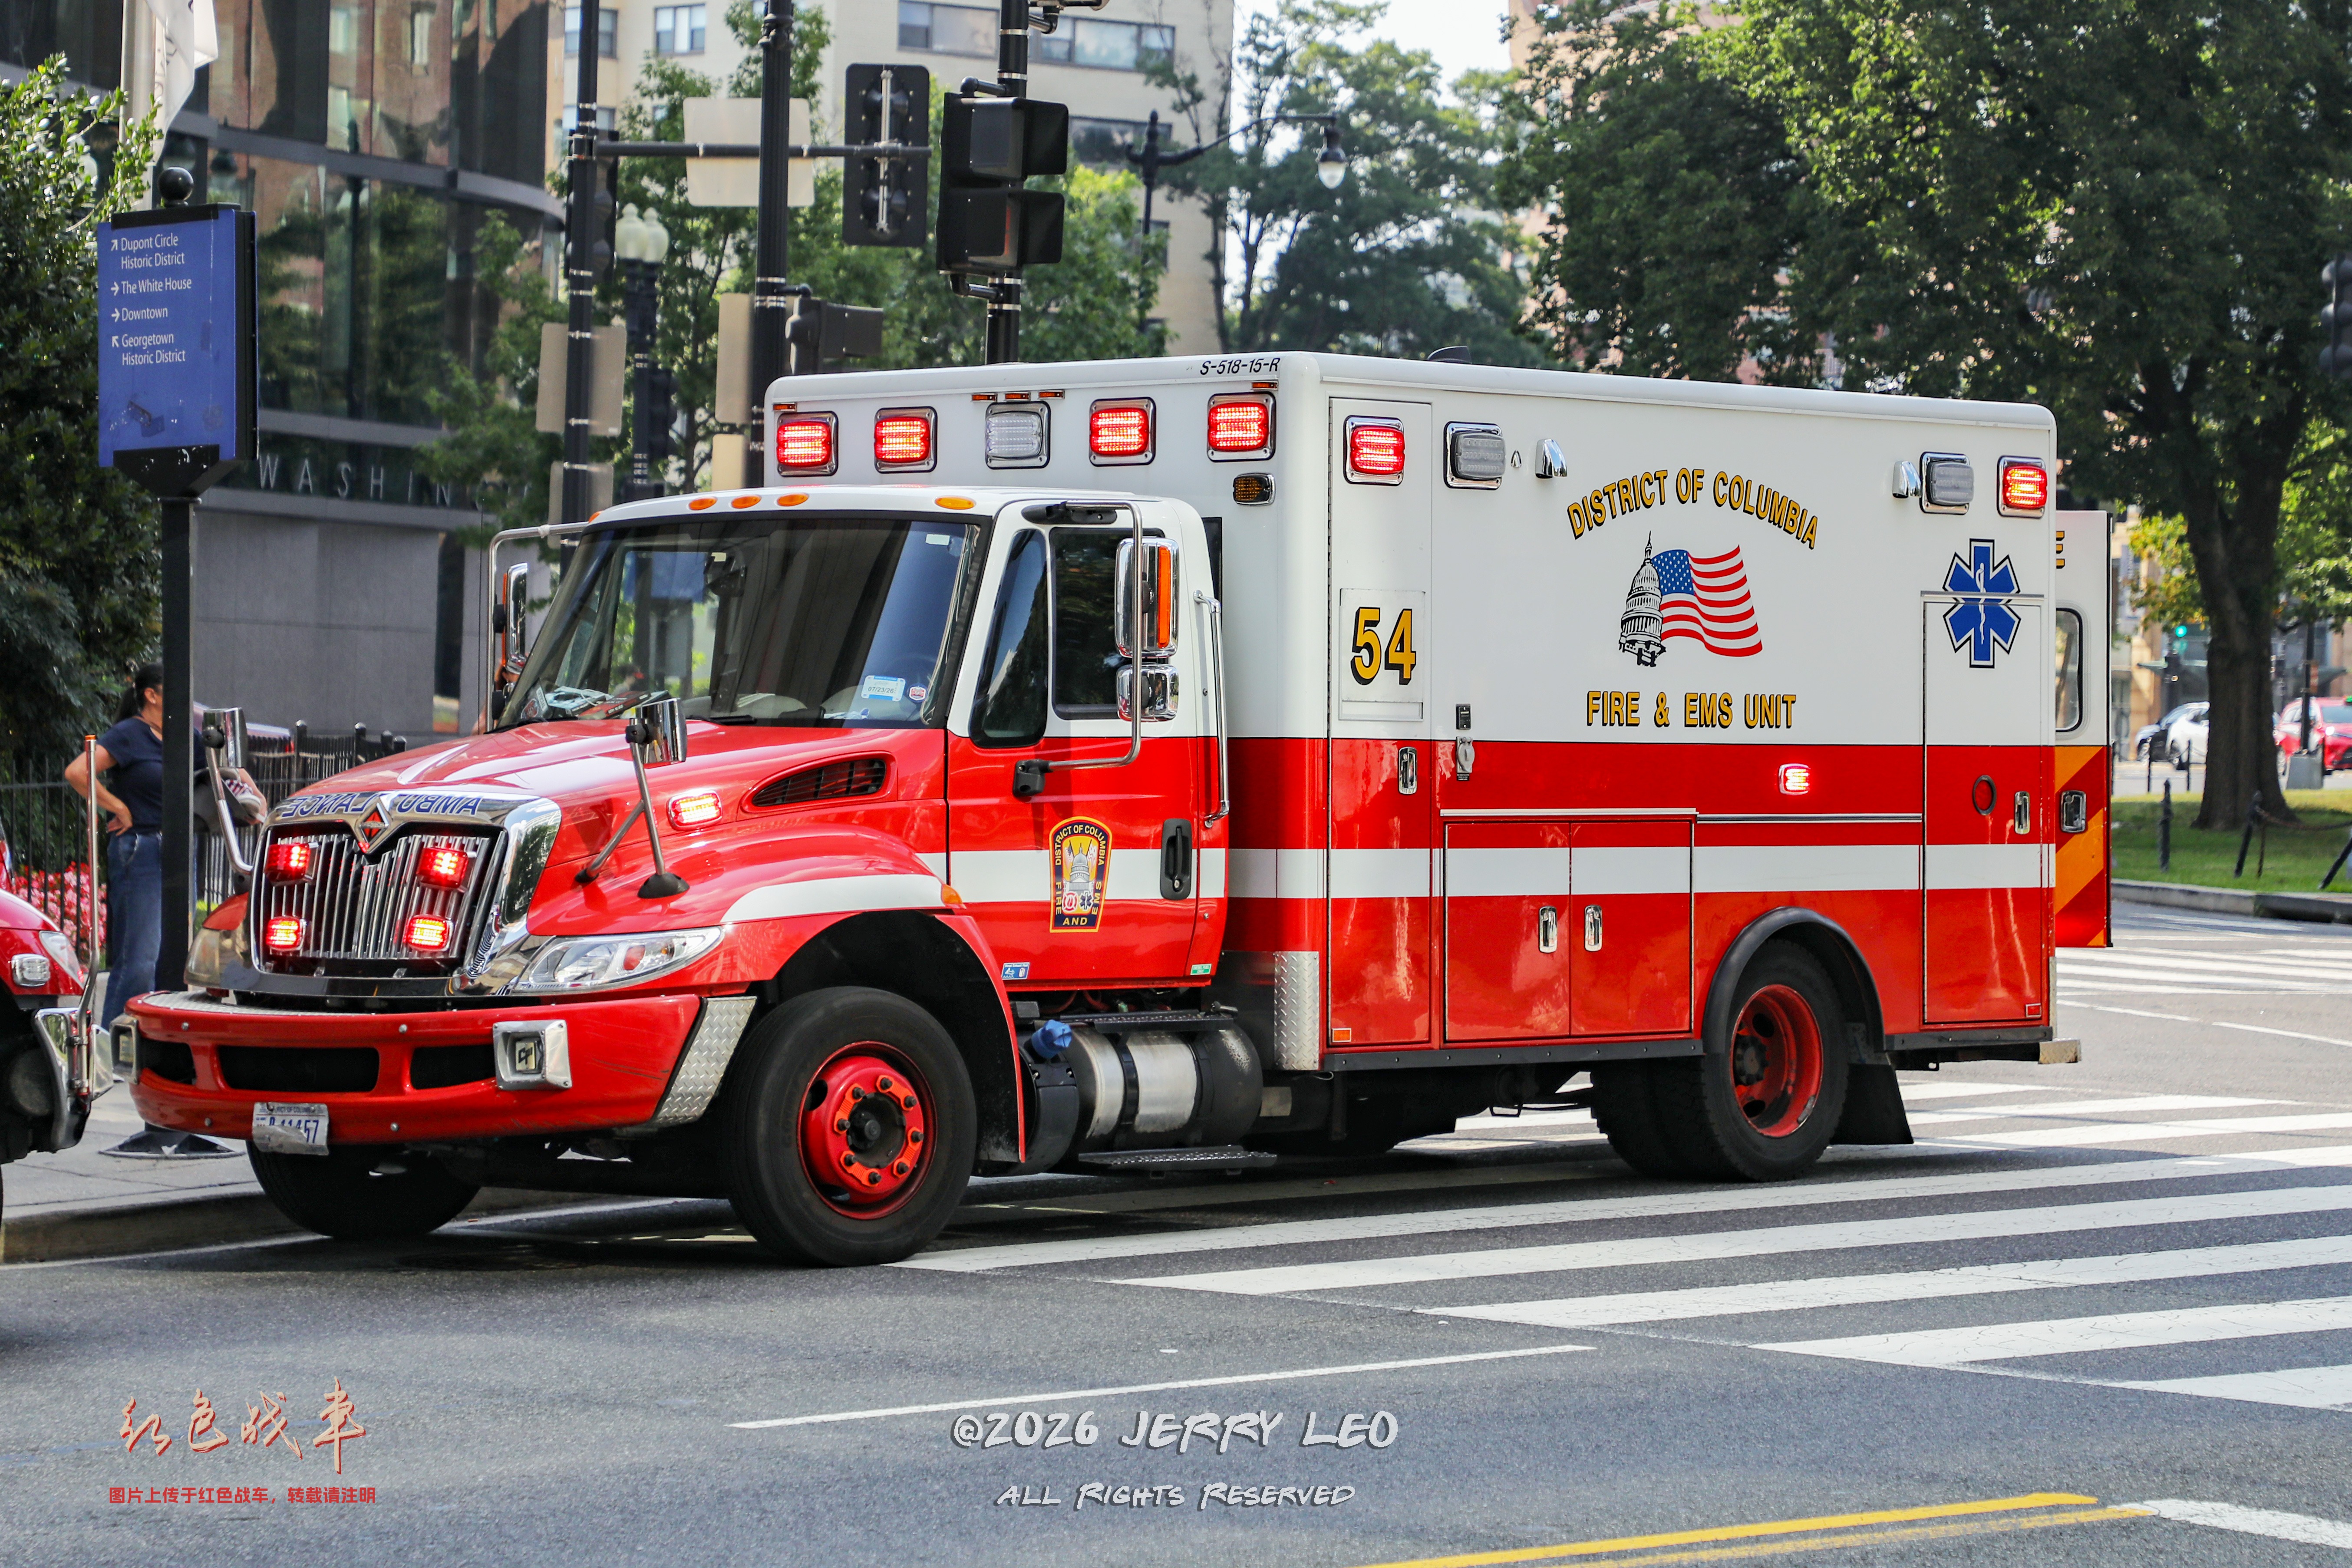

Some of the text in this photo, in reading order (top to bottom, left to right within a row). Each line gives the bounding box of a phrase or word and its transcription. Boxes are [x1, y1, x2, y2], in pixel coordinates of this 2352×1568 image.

[121, 233, 178, 253] Dupont Circle
[121, 251, 185, 269] Historic District
[121, 277, 192, 294] The White House
[122, 307, 168, 321] Downtown
[122, 333, 174, 349] Georgetown
[122, 348, 186, 366] Historic District
[1200, 357, 1280, 375] S-518-15-R
[1567, 468, 1818, 550] DISTRICT OF COLUMBIA
[1350, 607, 1416, 686] 54
[1587, 690, 1797, 729] FIRE & EMS UNIT
[1055, 825, 1106, 866] DISTRICT OF COLUMBIA
[1091, 881, 1102, 915] EMS
[1062, 917, 1088, 925] AND
